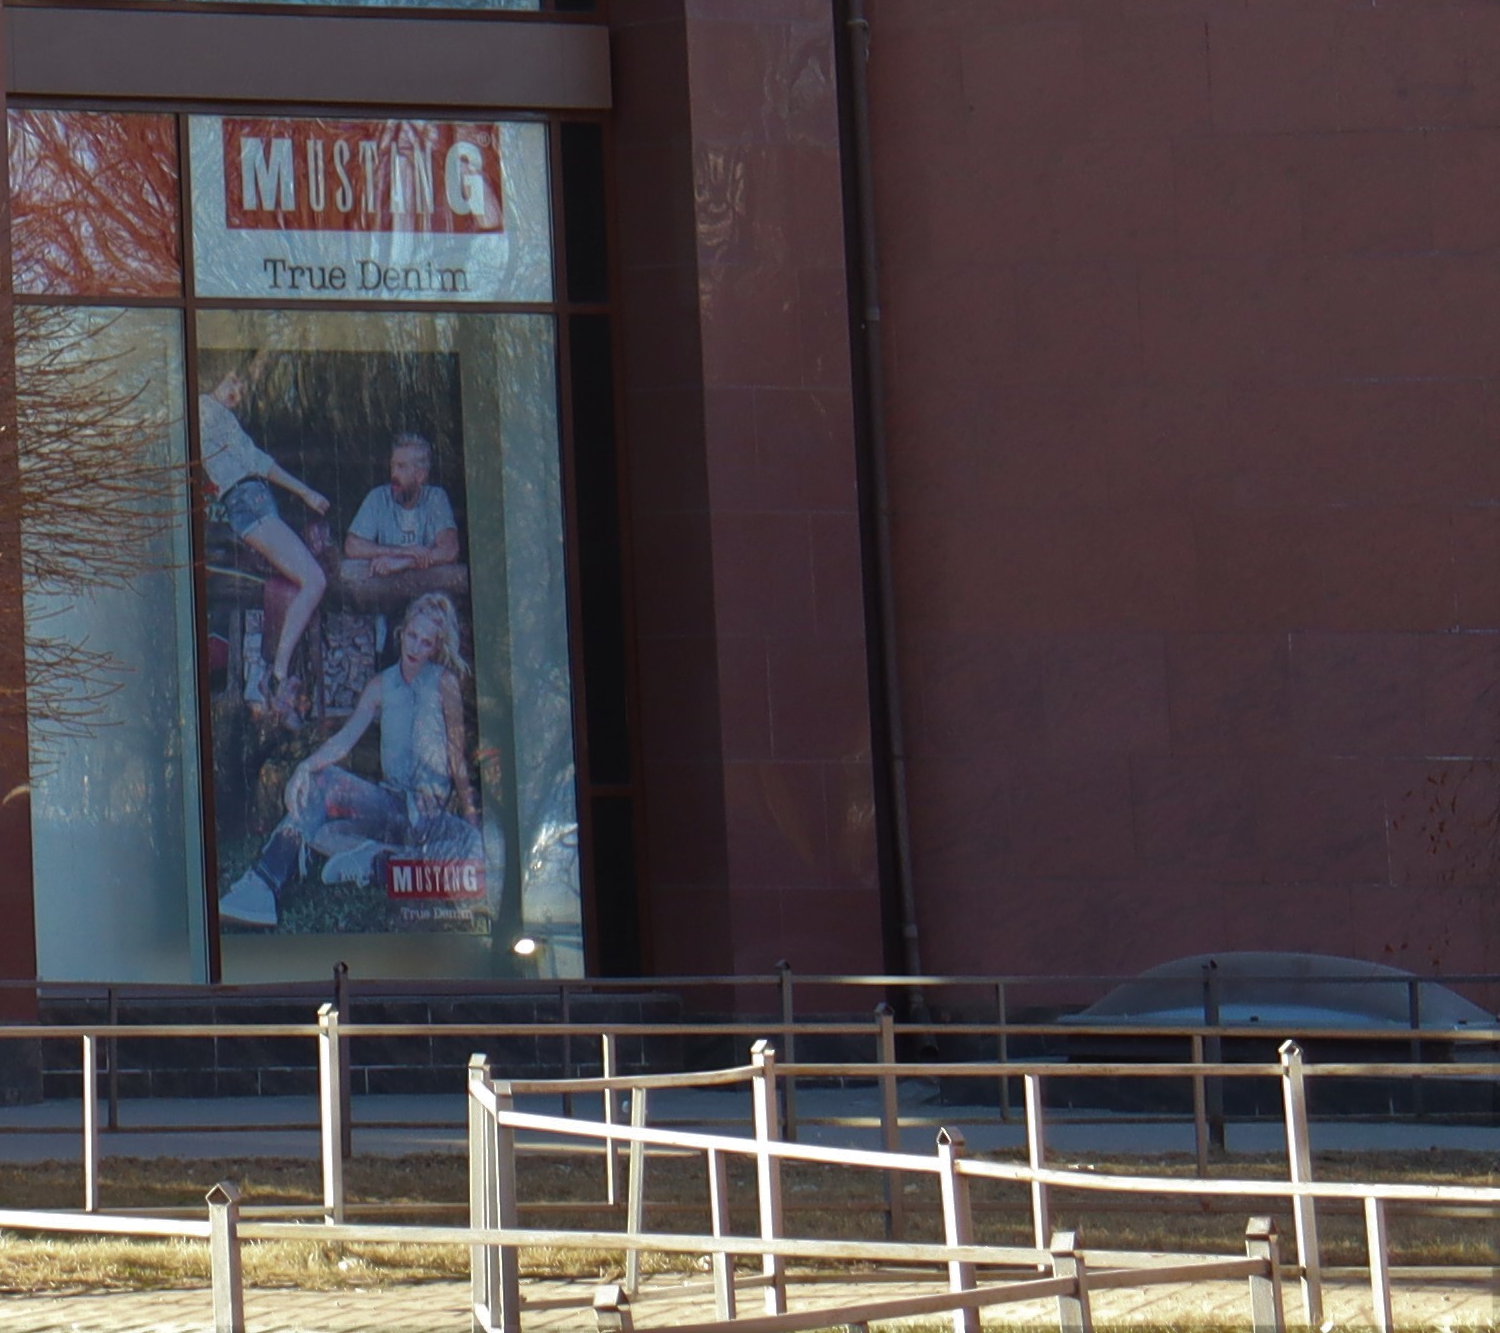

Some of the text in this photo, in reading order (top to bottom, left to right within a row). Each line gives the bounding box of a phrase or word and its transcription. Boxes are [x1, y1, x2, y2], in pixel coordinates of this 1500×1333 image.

[240, 136, 485, 216] MUSTANG
[263, 258, 472, 292] True Denim
[392, 864, 478, 893] MUSTANG
